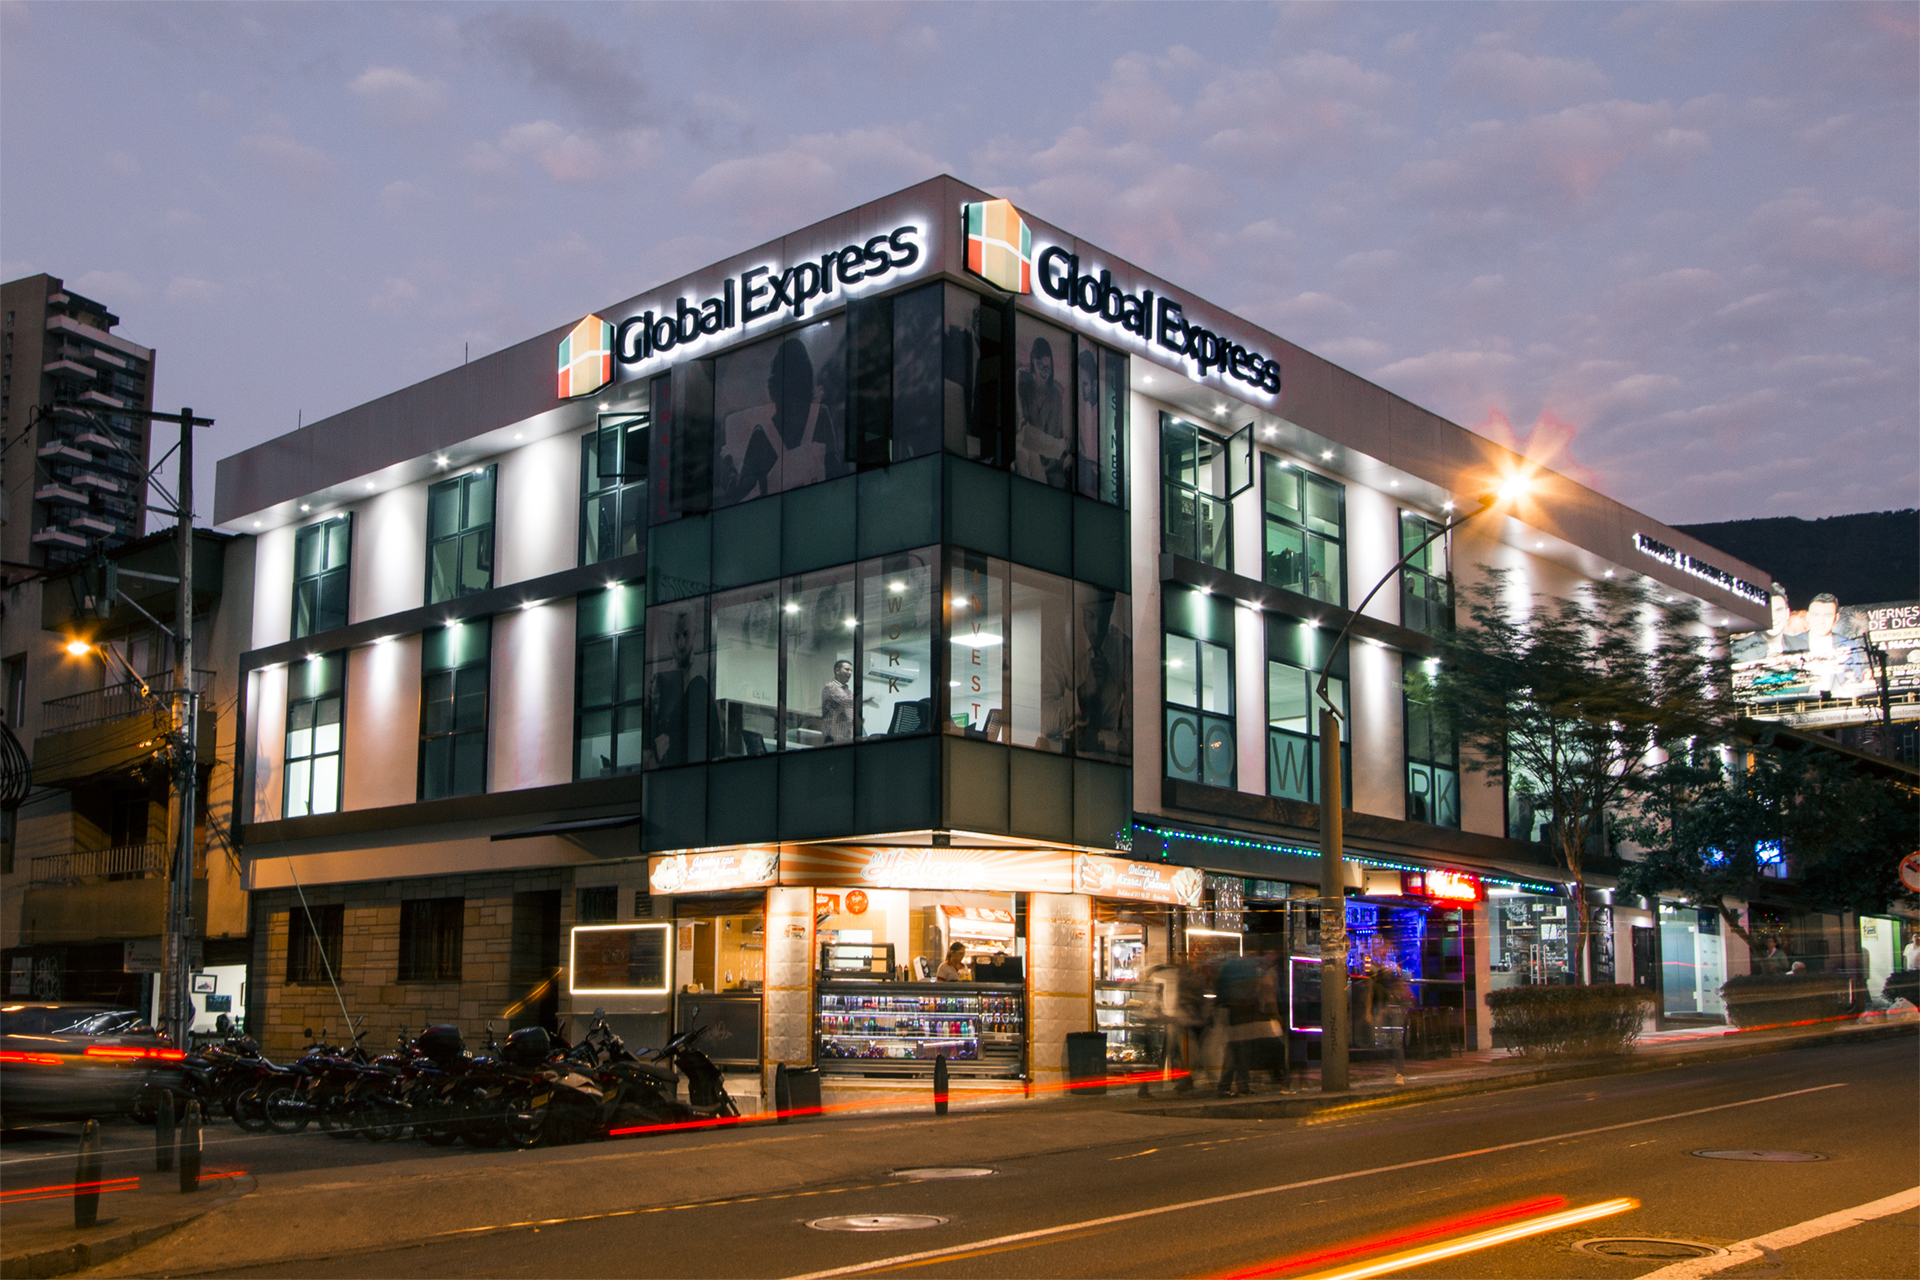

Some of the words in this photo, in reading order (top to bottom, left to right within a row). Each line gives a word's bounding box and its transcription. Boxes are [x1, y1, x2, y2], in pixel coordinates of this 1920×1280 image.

[616, 278, 736, 365] Global
[741, 225, 920, 323] Express
[1037, 245, 1154, 341] Global
[1157, 296, 1282, 395] Express
[659, 386, 671, 516] TRAVEL
[1867, 606, 1920, 621] VIERNES
[1868, 620, 1887, 631] DE
[887, 596, 902, 694] WORK
[971, 568, 982, 720] INVEST
[1825, 713, 1842, 722] tiene
[721, 855, 735, 865] con
[861, 849, 983, 881] Habana
[1128, 863, 1154, 878] Delicias
[1154, 870, 1161, 881] y
[1116, 873, 1142, 887] Ricuras
[1143, 876, 1171, 891] Cubanas
